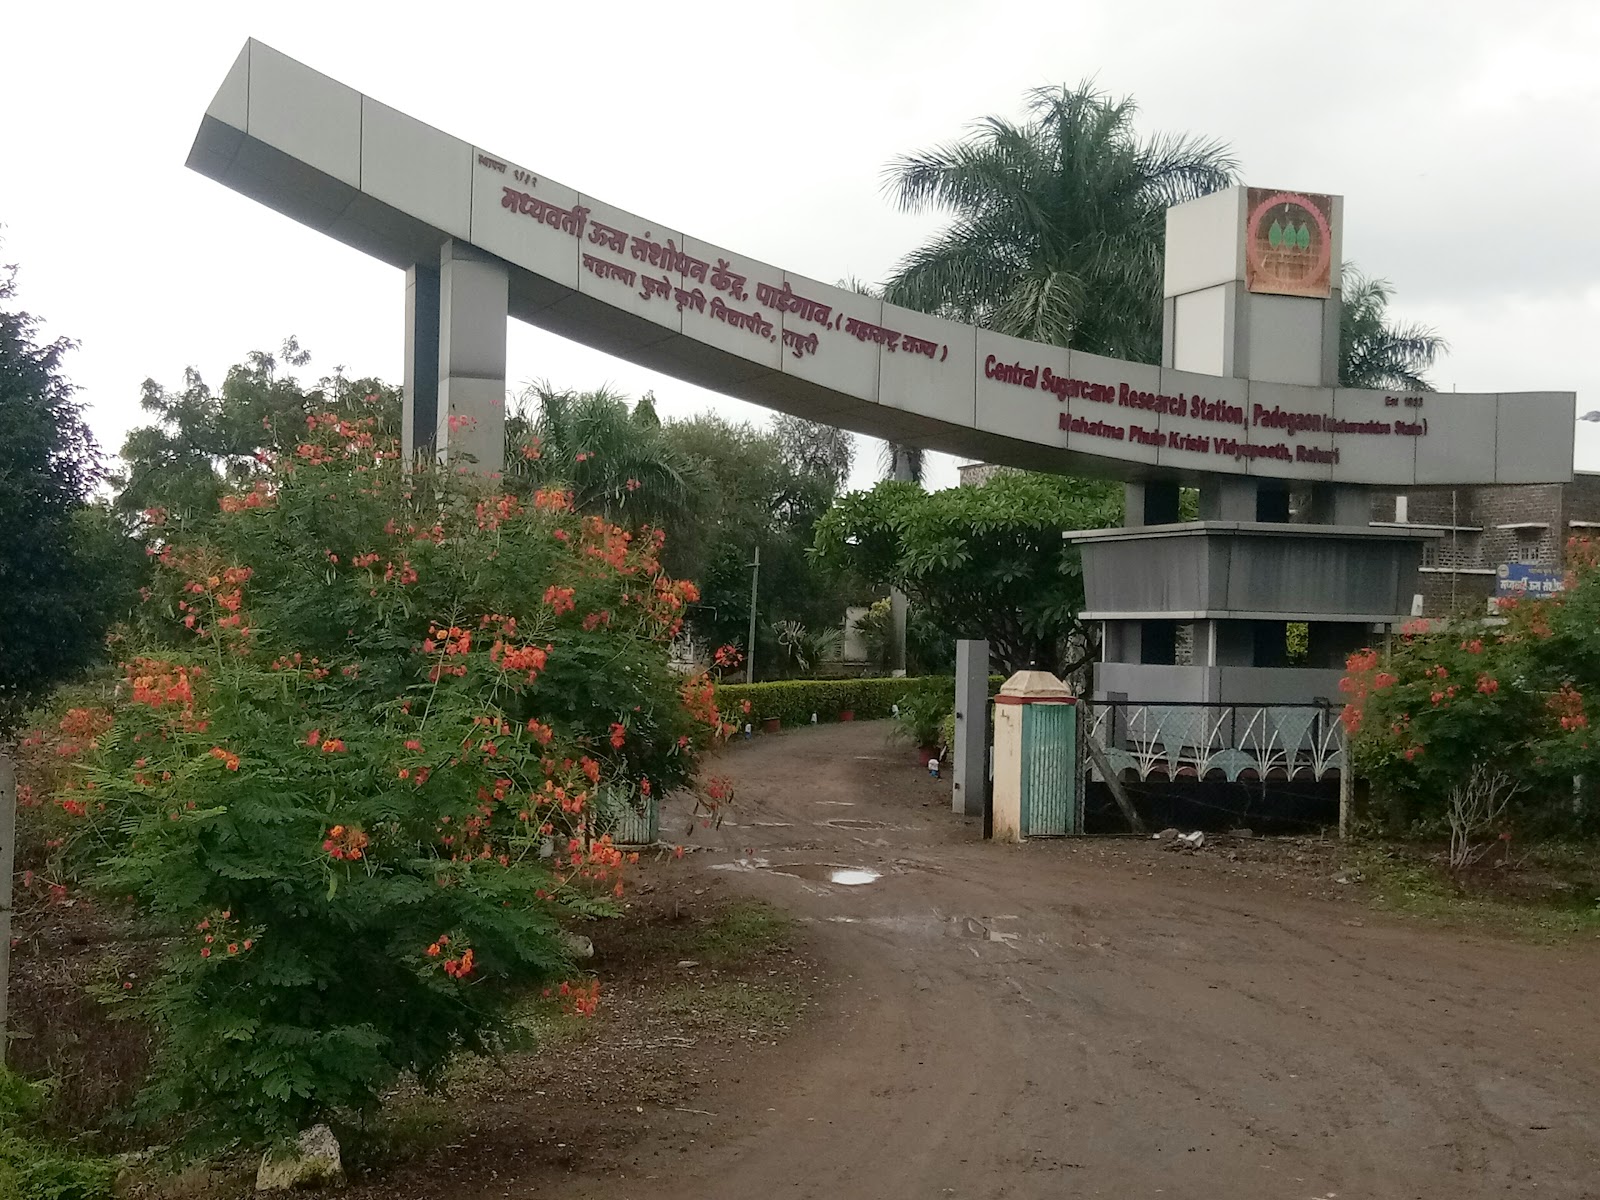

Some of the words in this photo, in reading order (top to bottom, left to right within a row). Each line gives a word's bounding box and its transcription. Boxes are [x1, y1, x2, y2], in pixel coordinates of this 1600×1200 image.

[501, 186, 590, 238] मध्यवर्ती
[588, 220, 628, 254] ऊस
[630, 231, 710, 284] संशोधन
[582, 252, 637, 288] महात्मा
[638, 274, 672, 300] फुले
[984, 354, 1039, 389] Central
[1040, 367, 1116, 405] Sugarcane
[1118, 382, 1187, 417] Research
[1190, 395, 1248, 430] Station,
[1252, 403, 1321, 436] Padegaon
[1058, 412, 1124, 440] Mahatma
[1129, 425, 1166, 447] Phule
[1168, 431, 1210, 453] Krishi
